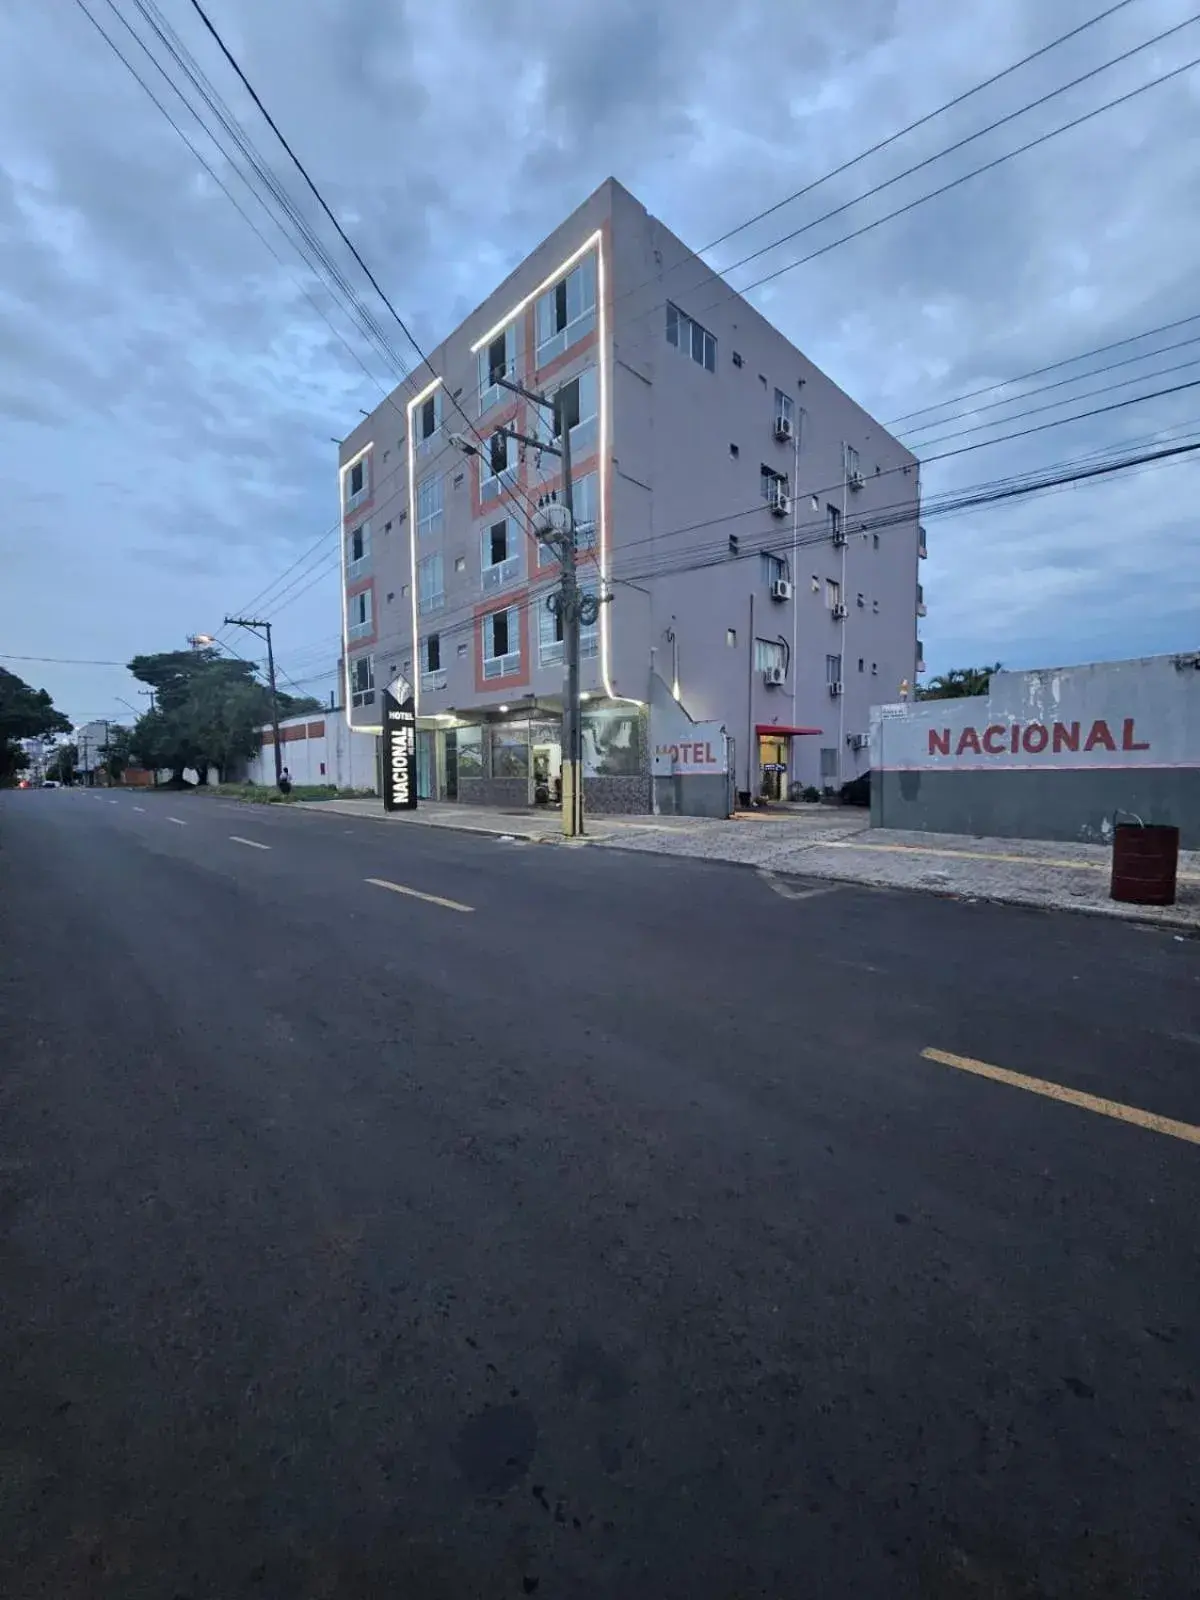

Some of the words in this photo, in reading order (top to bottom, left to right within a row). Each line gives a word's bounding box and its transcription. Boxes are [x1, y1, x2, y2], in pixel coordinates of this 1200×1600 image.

[388, 711, 414, 720] HOTEL
[928, 718, 1150, 755] NACIONAL
[391, 727, 408, 803] NACIONAL
